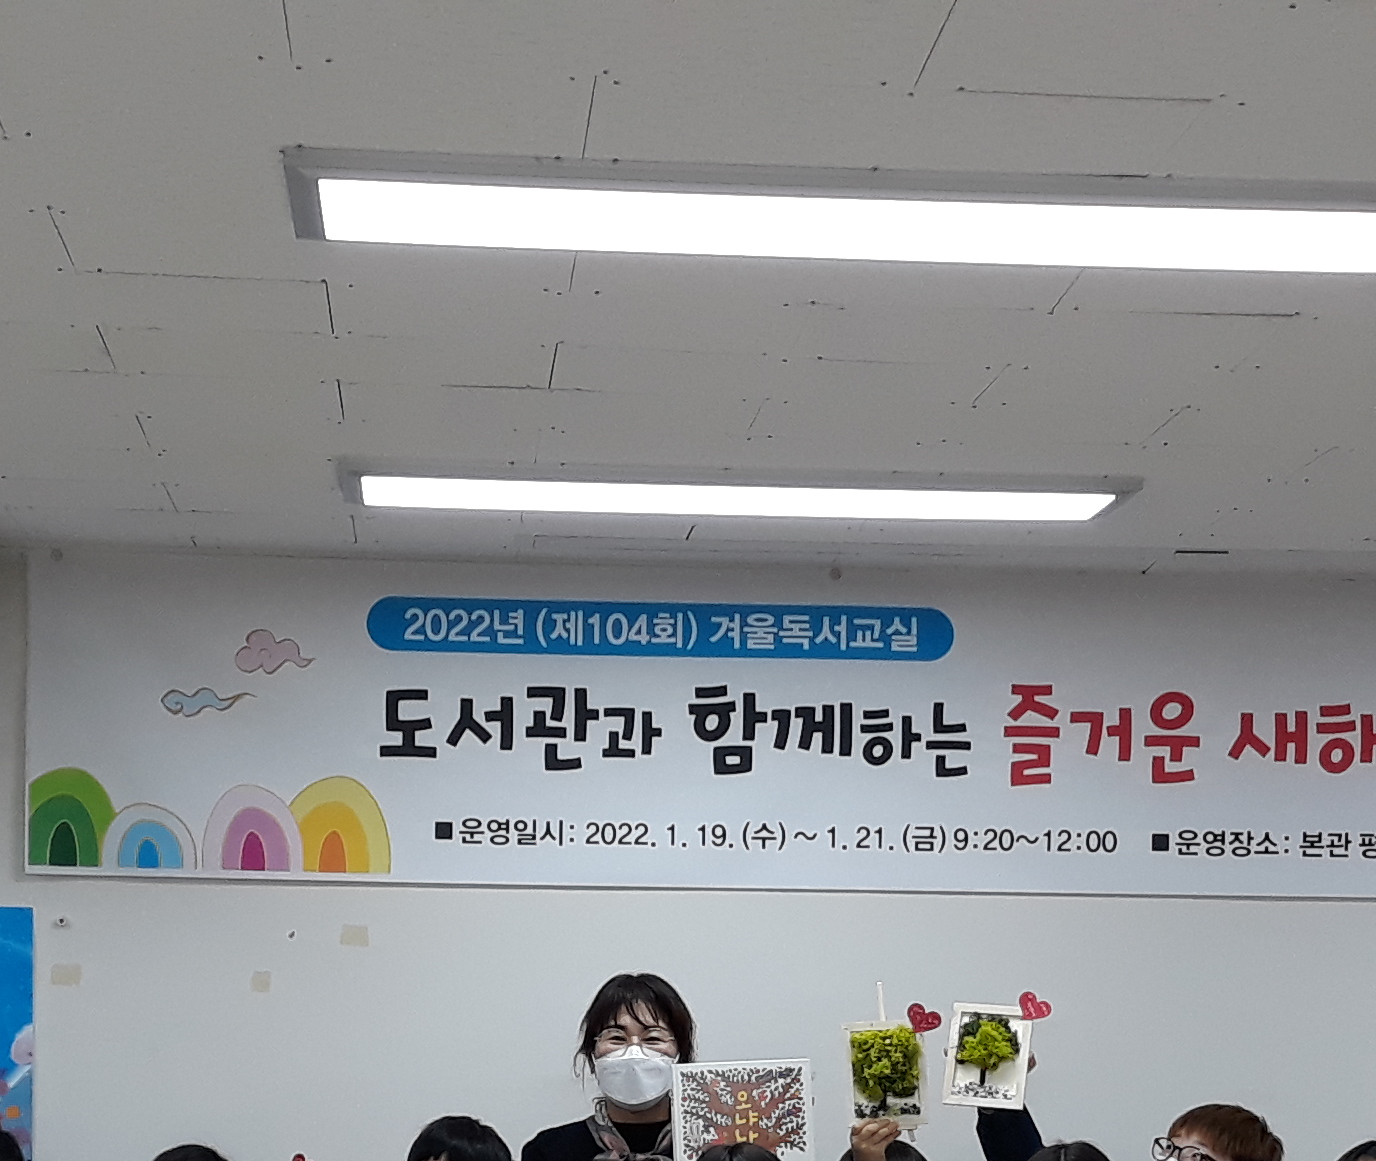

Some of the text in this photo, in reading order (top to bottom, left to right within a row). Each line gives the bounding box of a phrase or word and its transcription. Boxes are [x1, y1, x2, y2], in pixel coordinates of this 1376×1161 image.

[403, 607, 920, 653] 2022년 (제104회) 겨울독서교실
[379, 685, 662, 772] 도서관과
[688, 684, 971, 777] 함께하는
[1003, 683, 1200, 786] 즐거운
[458, 817, 576, 847] 운영일시:
[585, 822, 657, 848] 2022.
[666, 824, 687, 848] 1.
[827, 826, 848, 850] 1.
[856, 826, 894, 851] 21.
[1175, 829, 1290, 857] 운영장소:
[1299, 831, 1352, 858] 본관
